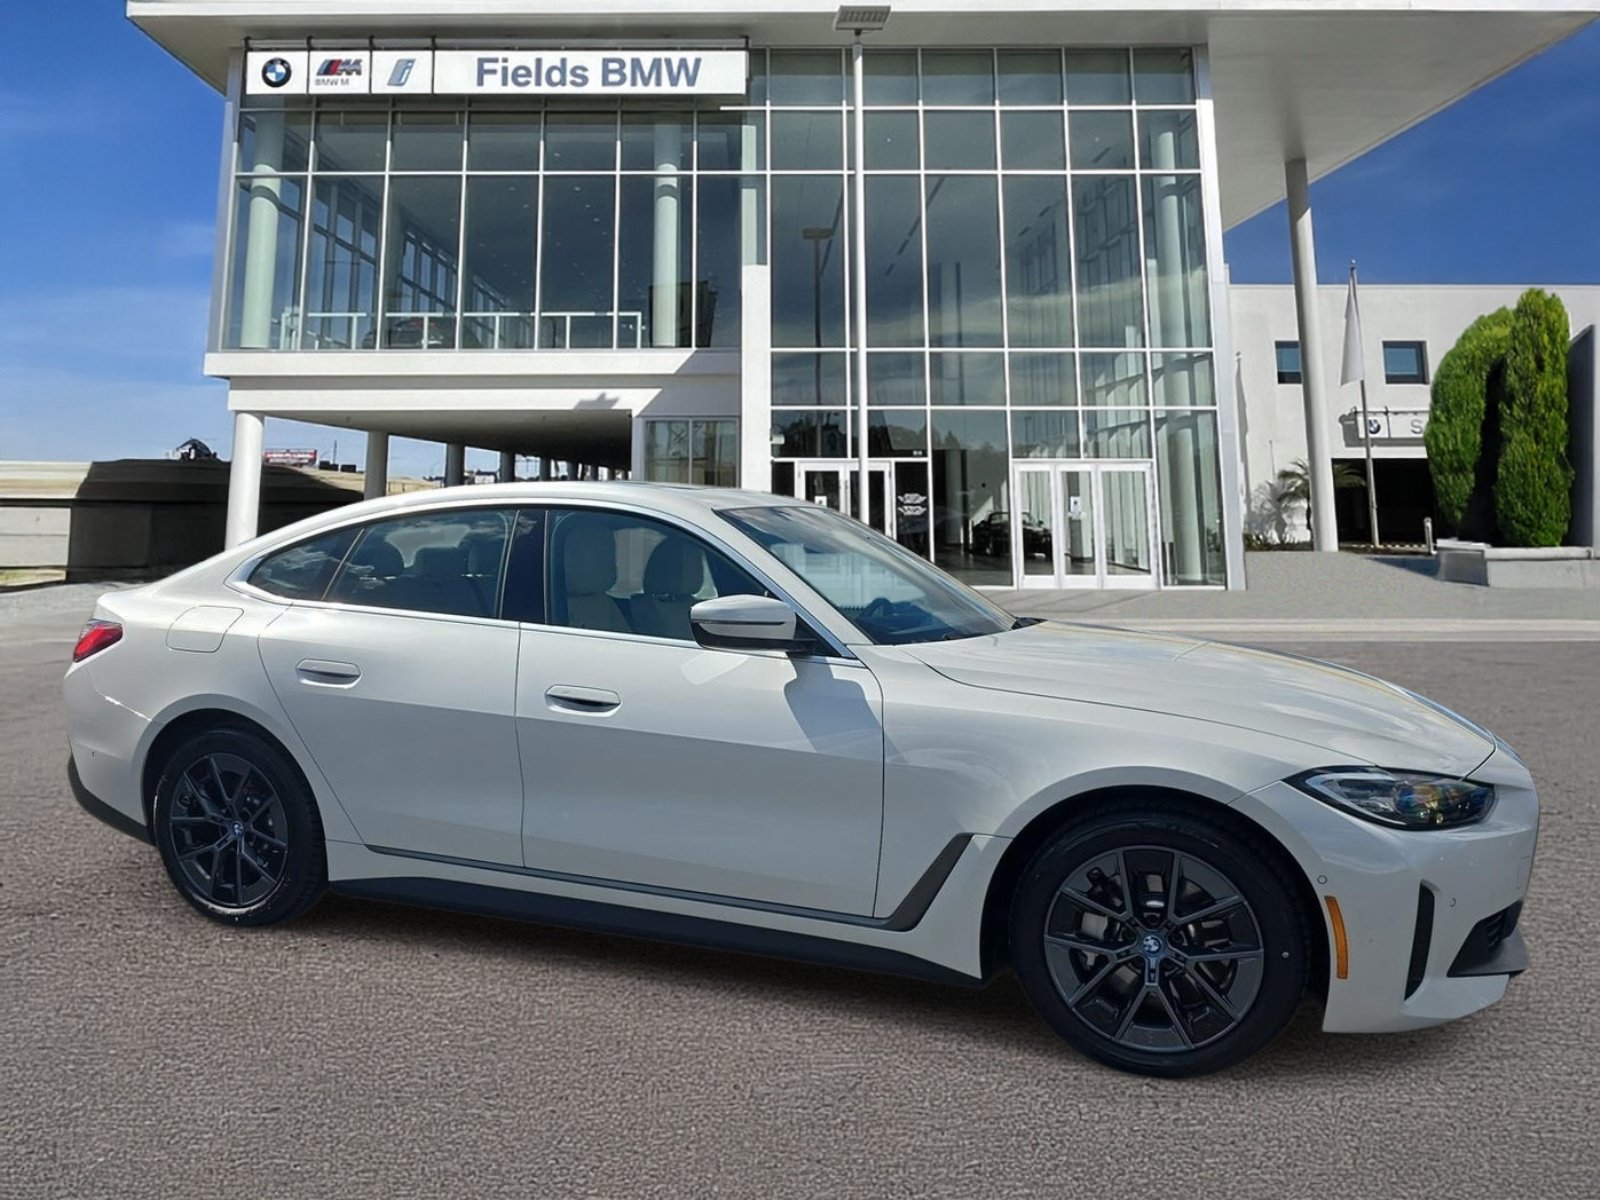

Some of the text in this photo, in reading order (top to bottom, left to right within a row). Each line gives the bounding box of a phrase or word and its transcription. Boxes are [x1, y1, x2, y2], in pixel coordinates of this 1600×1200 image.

[476, 58, 701, 87] Fields BMW
[315, 78, 339, 86] BMW
[1410, 418, 1424, 435] S
